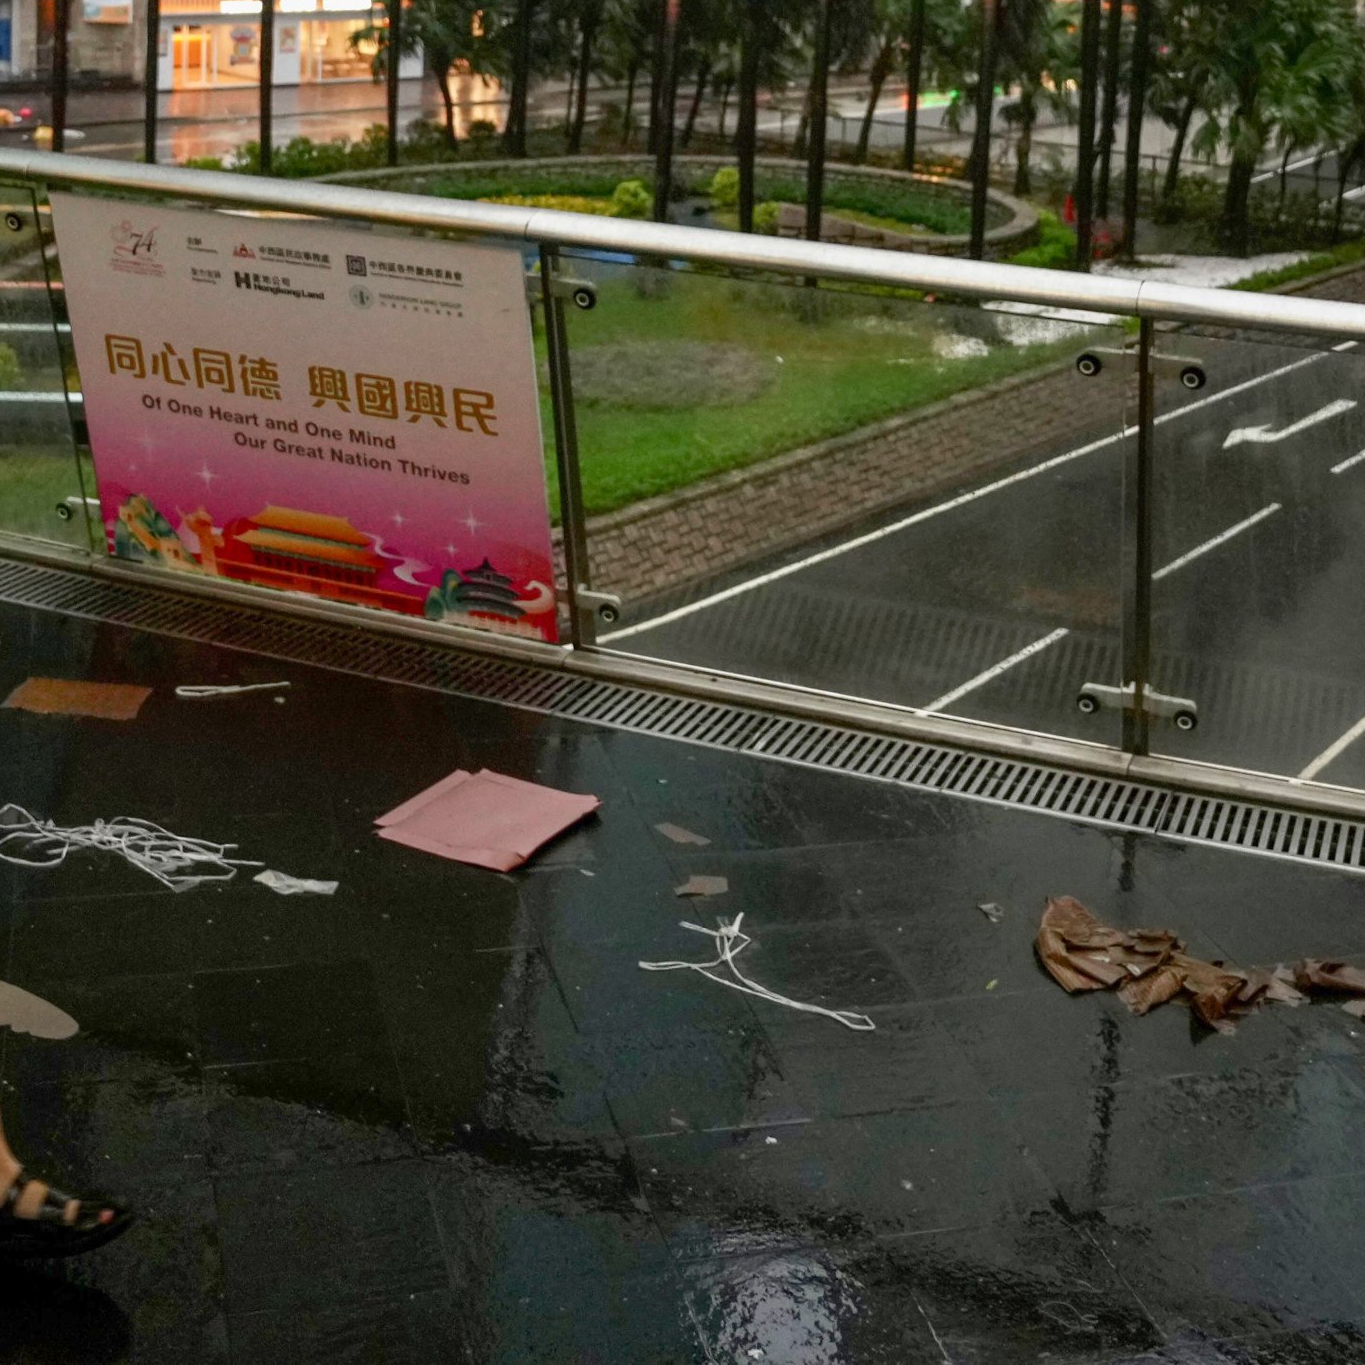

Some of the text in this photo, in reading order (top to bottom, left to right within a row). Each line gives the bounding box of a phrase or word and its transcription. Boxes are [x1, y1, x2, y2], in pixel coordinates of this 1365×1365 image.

[105, 334, 499, 437] 同心同德 興國興民
[142, 393, 396, 450] Of One Heart and One Mind
[234, 432, 471, 486] Our Great Nation Thrives
